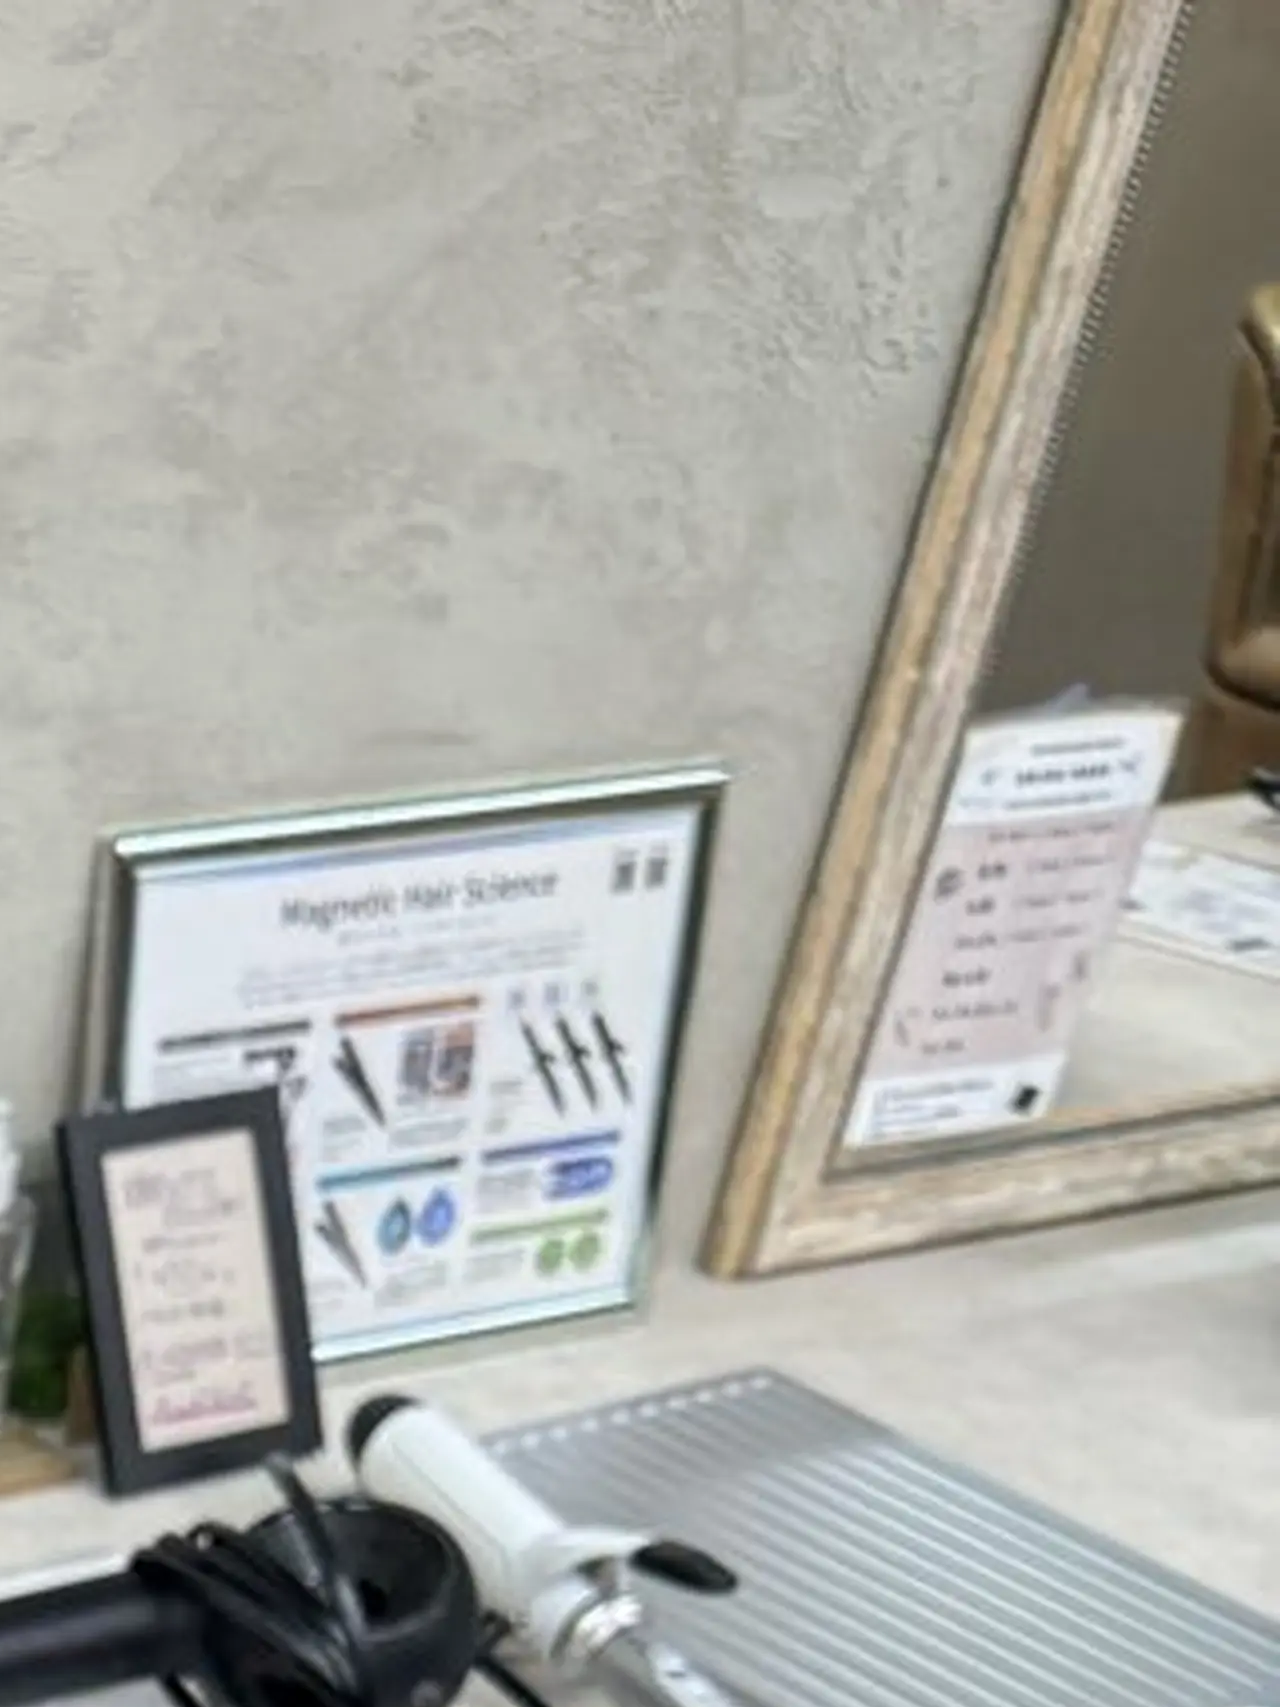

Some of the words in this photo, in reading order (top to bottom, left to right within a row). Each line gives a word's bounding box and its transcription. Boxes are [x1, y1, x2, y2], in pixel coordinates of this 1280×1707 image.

[280, 883, 397, 930] Magnetic
[403, 877, 455, 908] Hair
[462, 869, 559, 906] Science
